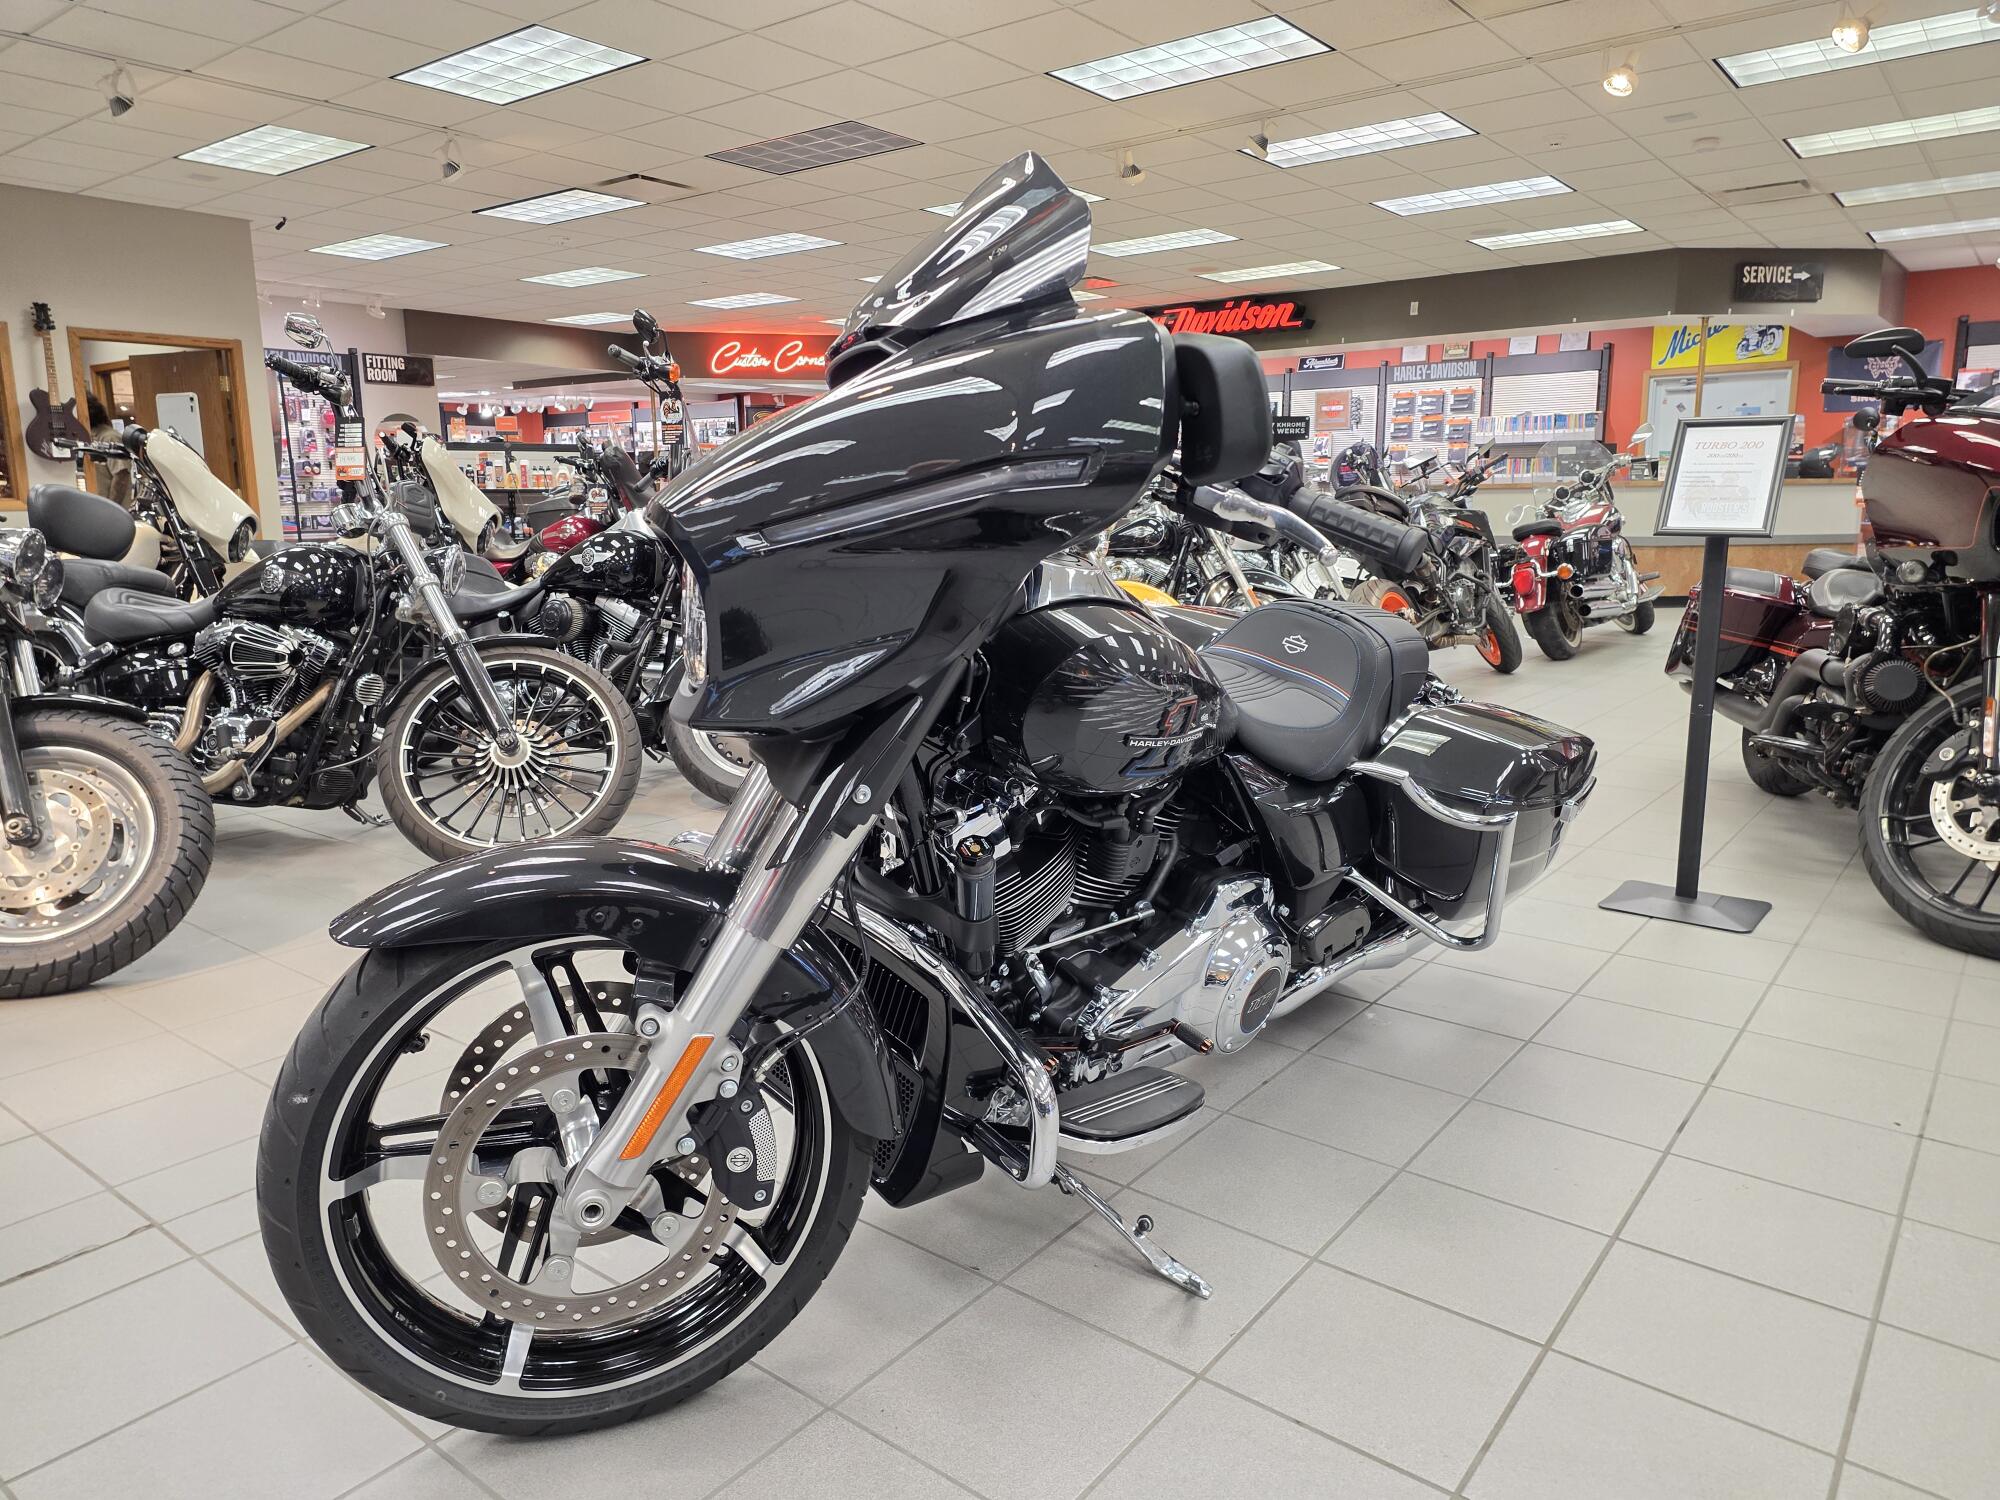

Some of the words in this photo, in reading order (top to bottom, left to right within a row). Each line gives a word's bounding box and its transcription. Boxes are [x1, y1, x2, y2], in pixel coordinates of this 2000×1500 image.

[1742, 265, 1793, 284] SERVICE
[365, 354, 406, 370] FITTING
[711, 341, 771, 374] Custom
[773, 340, 825, 373] Corne
[366, 368, 398, 382] ROOM
[1276, 427, 1306, 435] WERKS
[1695, 440, 1738, 450] TURBO
[1740, 439, 1765, 449] 200
[1129, 732, 1204, 747] HARLEY-DAVIDSON
